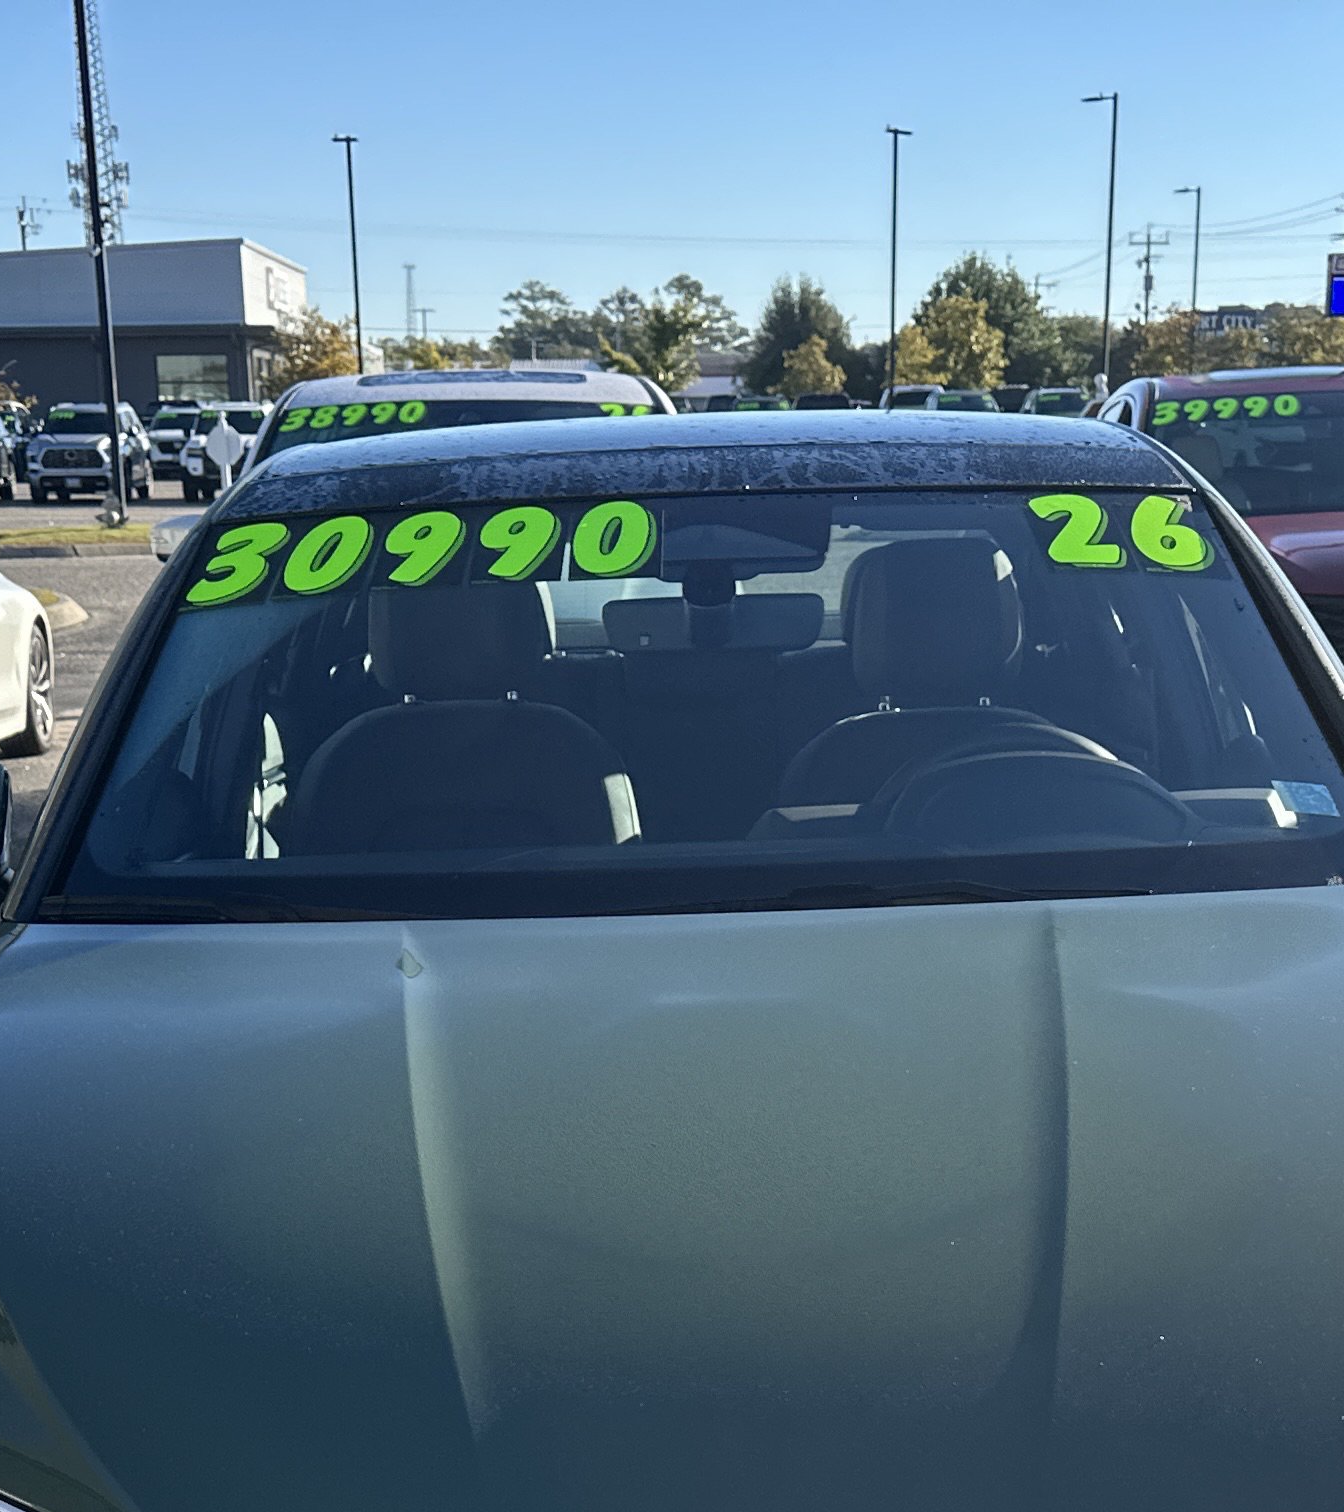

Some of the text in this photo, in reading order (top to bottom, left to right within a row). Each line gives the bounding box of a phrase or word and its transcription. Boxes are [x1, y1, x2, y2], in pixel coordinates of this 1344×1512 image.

[279, 401, 427, 432] 38990
[1152, 394, 1301, 426] 39990
[186, 494, 1215, 606] 30990 26
